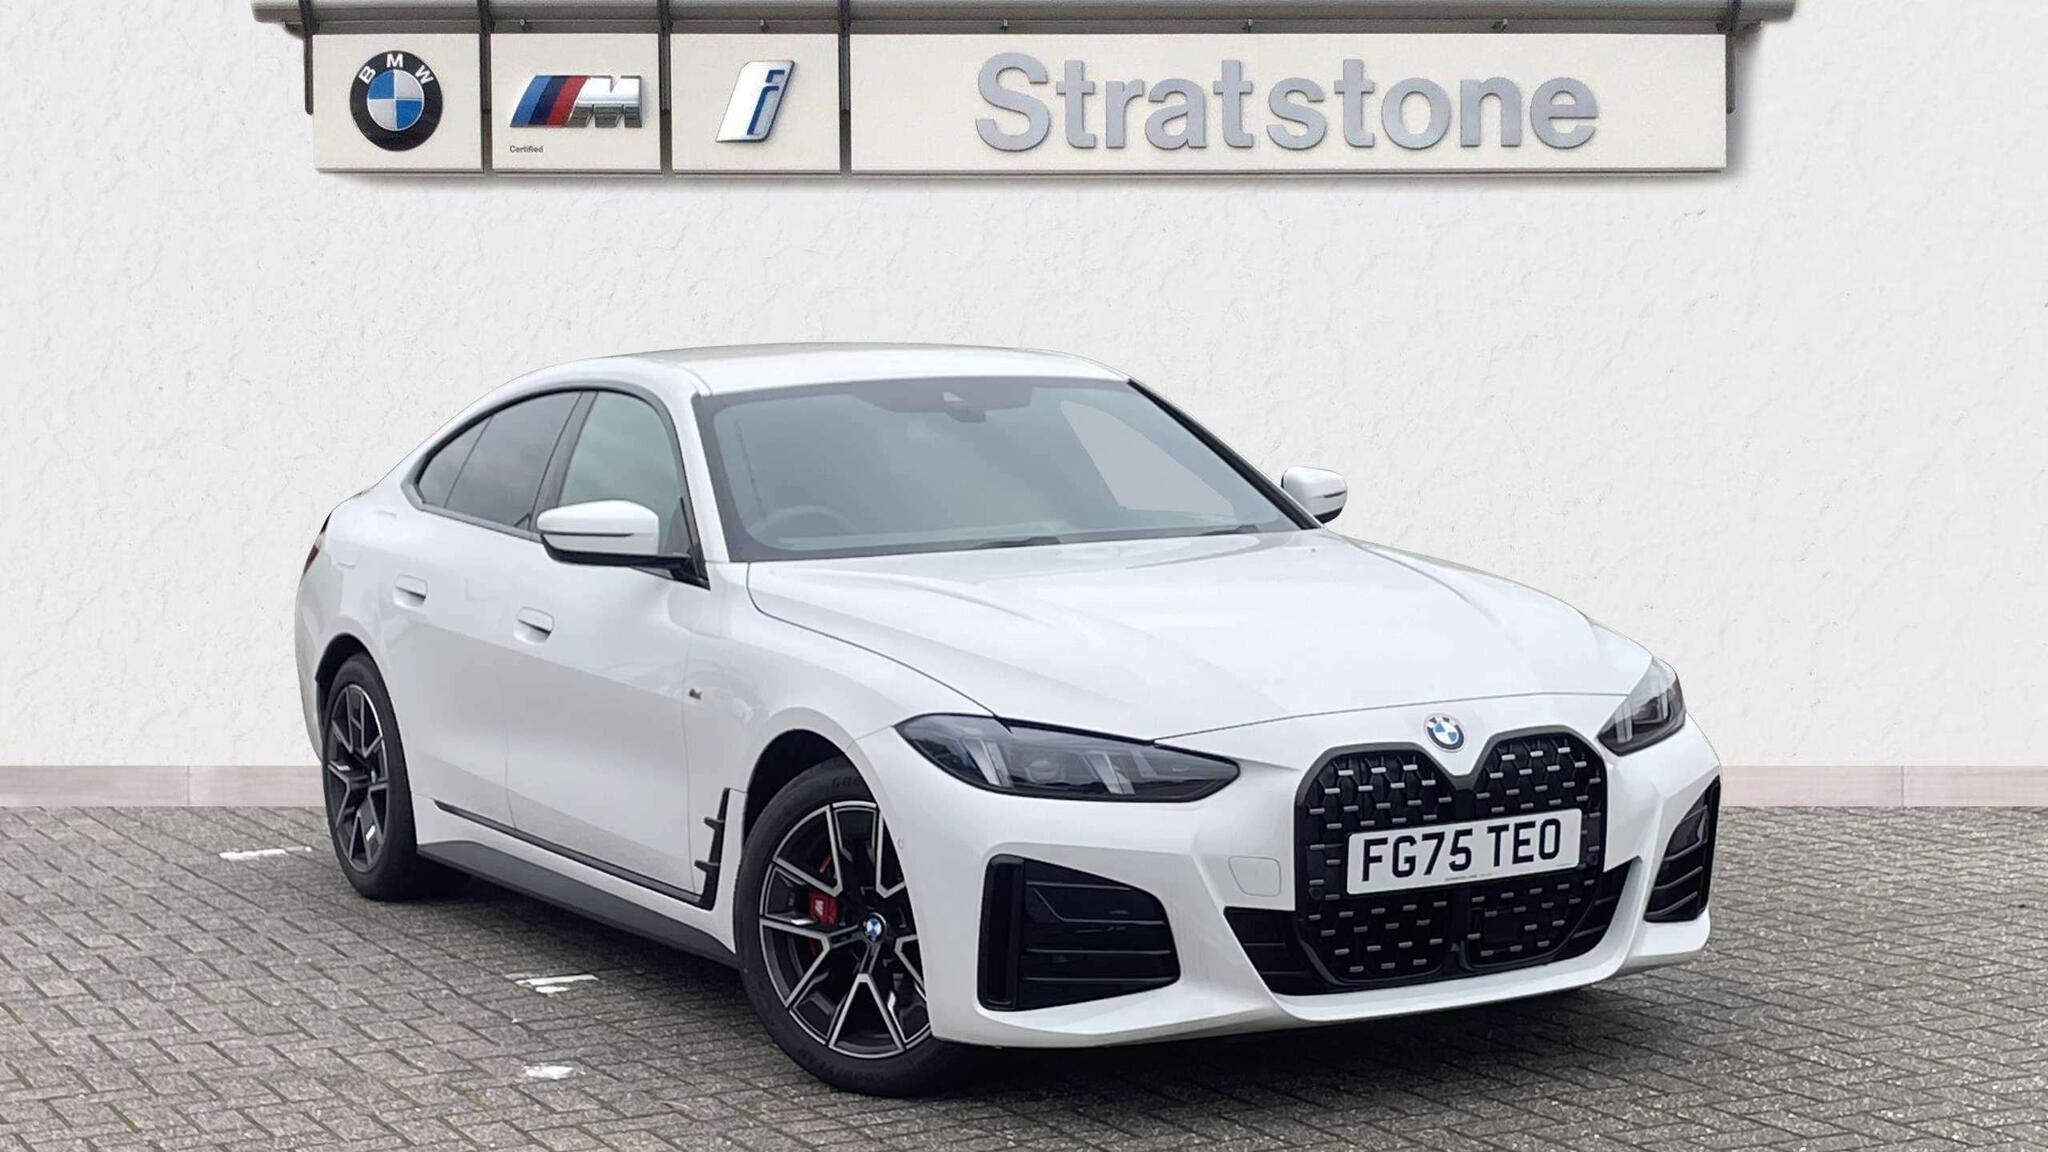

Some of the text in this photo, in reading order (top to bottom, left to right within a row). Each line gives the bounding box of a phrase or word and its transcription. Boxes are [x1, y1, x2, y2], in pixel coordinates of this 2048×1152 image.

[358, 53, 434, 84] BMW
[975, 51, 1599, 151] Stratstone
[509, 145, 544, 153] Certified
[1361, 818, 1561, 882] FG75 TEO
